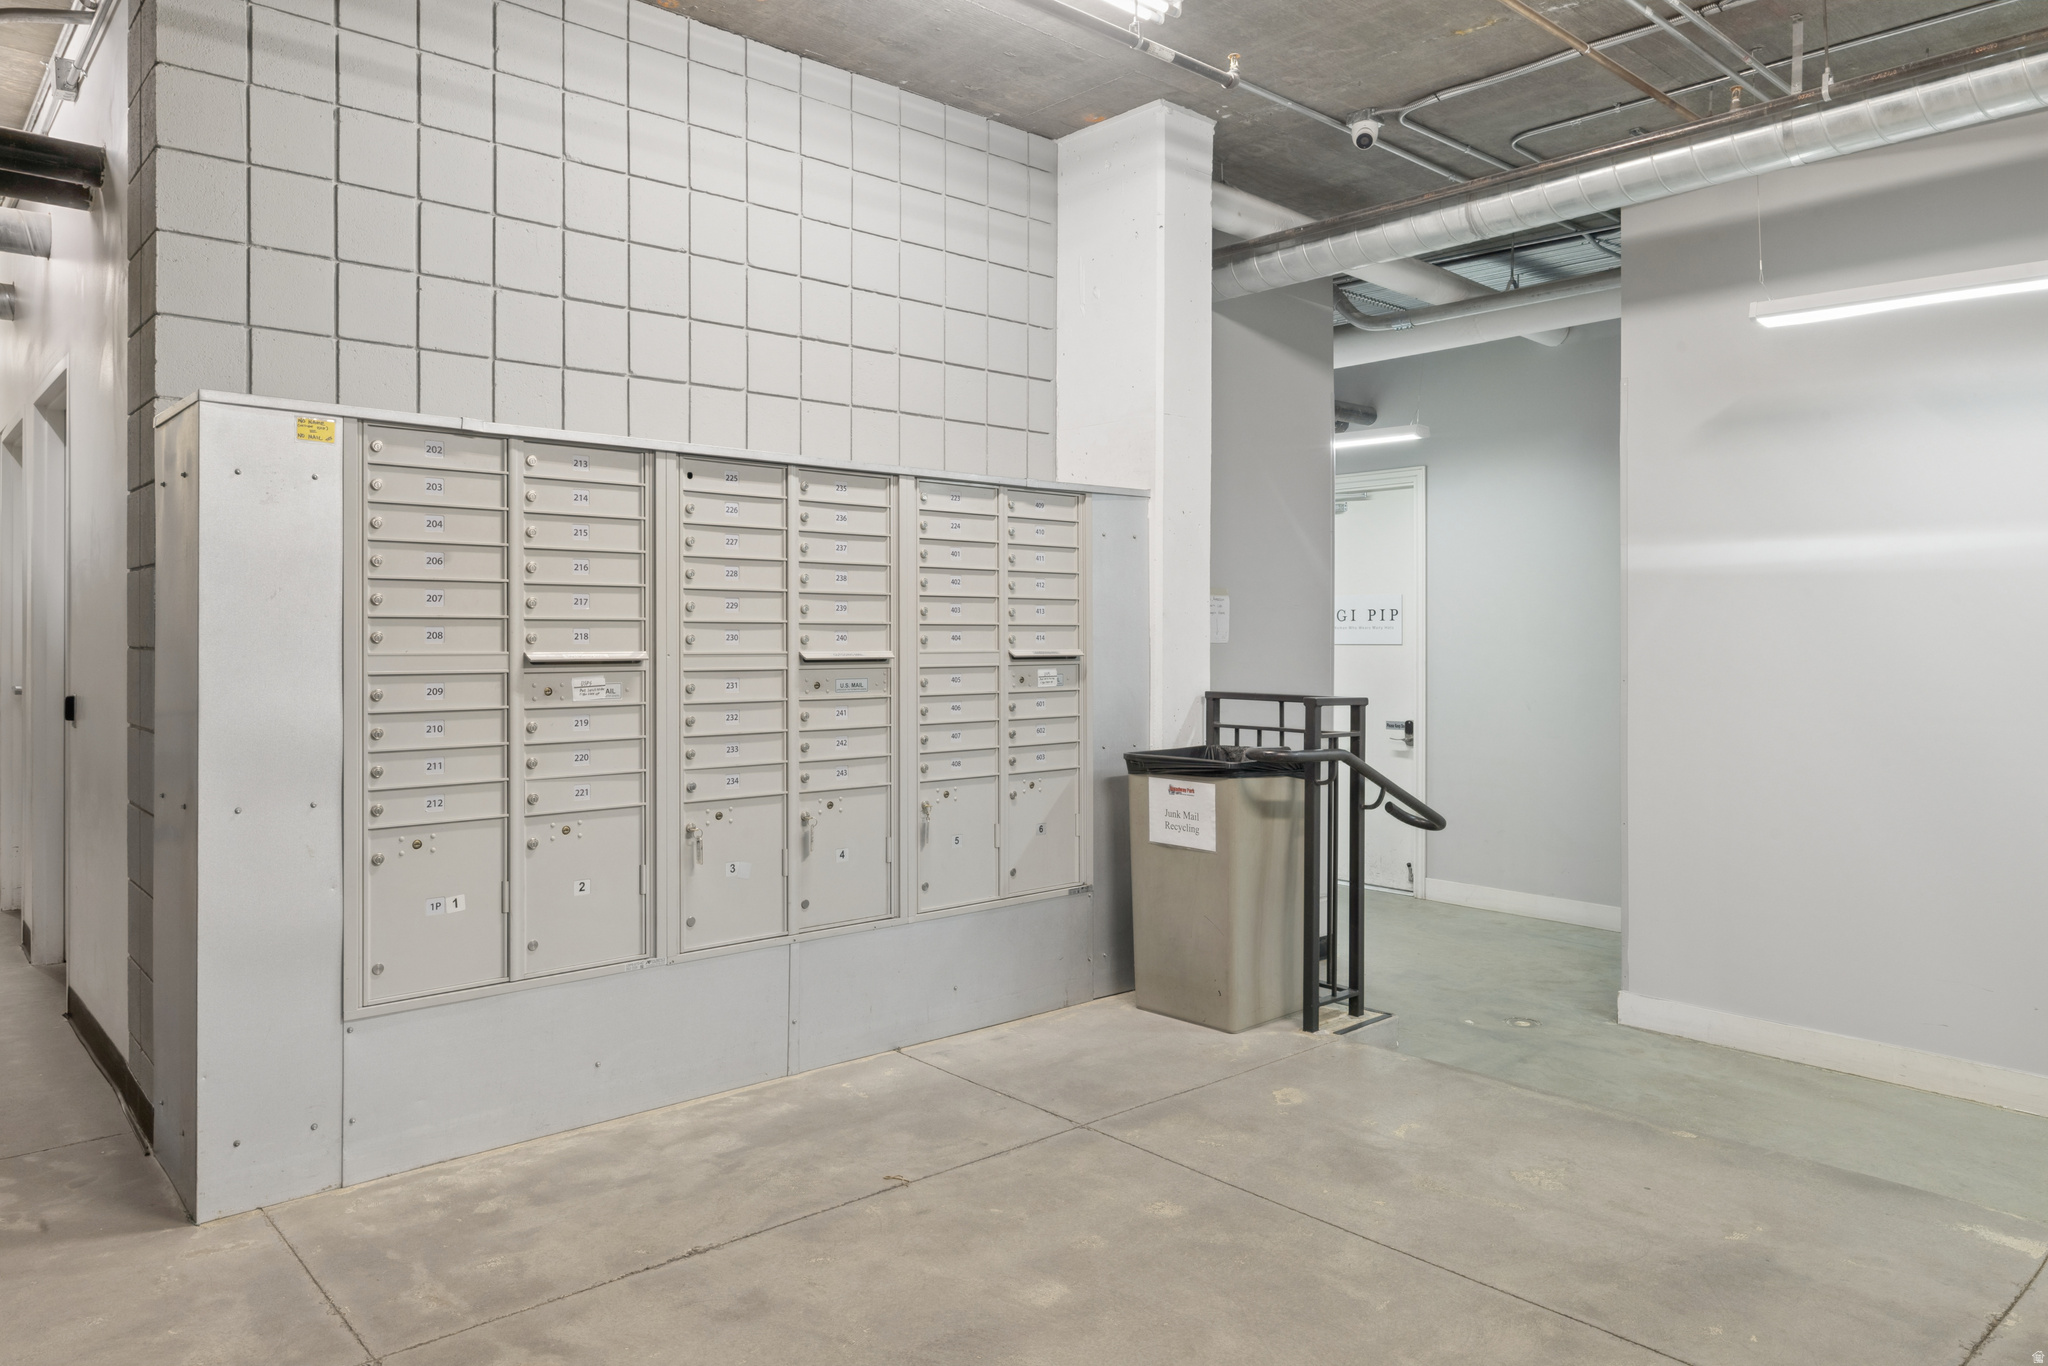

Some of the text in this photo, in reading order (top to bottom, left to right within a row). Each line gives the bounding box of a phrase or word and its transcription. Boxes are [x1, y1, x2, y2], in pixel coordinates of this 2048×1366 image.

[425, 444, 443, 454] 202
[573, 459, 588, 468] 213
[725, 474, 738, 482] 225
[425, 482, 443, 492] 203
[835, 484, 847, 492] 235
[573, 493, 589, 502] 214
[725, 506, 738, 514] 226
[835, 514, 847, 522] 236
[425, 519, 444, 528] 204
[573, 528, 589, 537] 215
[725, 538, 738, 546] 227
[426, 556, 443, 566] 206
[573, 563, 589, 572] 216
[835, 574, 847, 582] 238
[426, 593, 443, 603] 207
[573, 597, 589, 606] 217
[835, 604, 847, 612] 239
[1368, 609, 1398, 621] PIP
[426, 630, 444, 640] 208
[573, 632, 589, 641] 218
[835, 634, 847, 642] 240
[951, 676, 961, 684] 405
[426, 687, 444, 696] 209
[835, 709, 847, 717] 241
[725, 714, 739, 722] 232
[574, 719, 589, 727] 219
[426, 724, 443, 733] 210
[836, 739, 847, 747] 242
[574, 754, 589, 762] 220
[426, 762, 442, 771] 211
[836, 769, 848, 777] 243
[726, 777, 739, 785] 234
[574, 788, 589, 797] 221
[426, 798, 443, 808] 212
[1165, 809, 1199, 821] Junk Mail
[1038, 825, 1044, 833] 6
[1165, 821, 1200, 836] Recycling
[954, 837, 960, 845] 5
[839, 850, 845, 859] 4
[729, 864, 736, 873] 3
[578, 881, 585, 892] 2
[430, 902, 442, 911] 1P
[452, 898, 458, 908] 1
